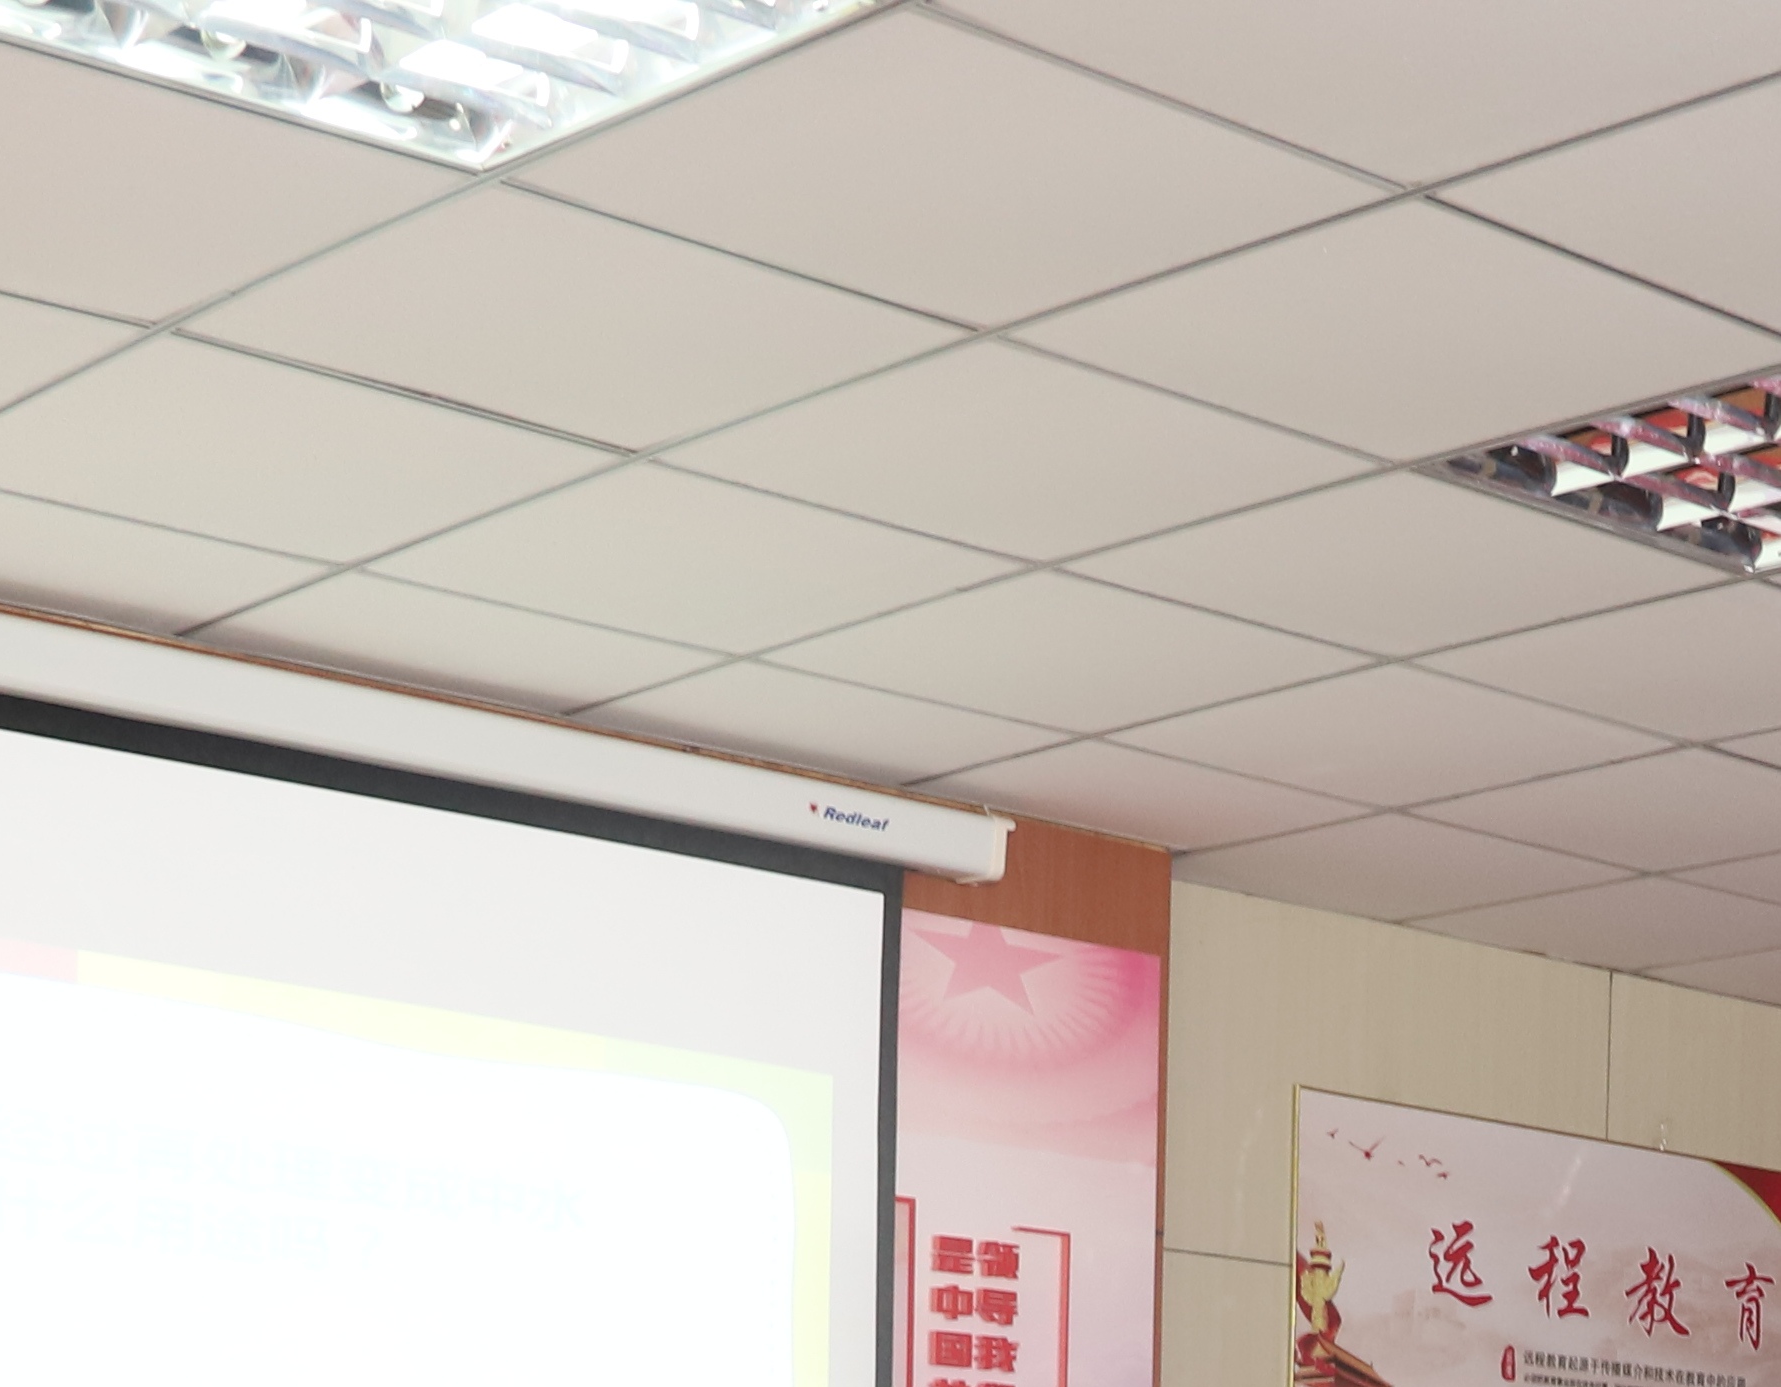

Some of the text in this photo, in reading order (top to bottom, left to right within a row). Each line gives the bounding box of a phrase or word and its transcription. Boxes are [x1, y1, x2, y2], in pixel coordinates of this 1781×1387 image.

[823, 805, 889, 831] Redleaf
[1429, 1220, 1776, 1350] 远程教育
